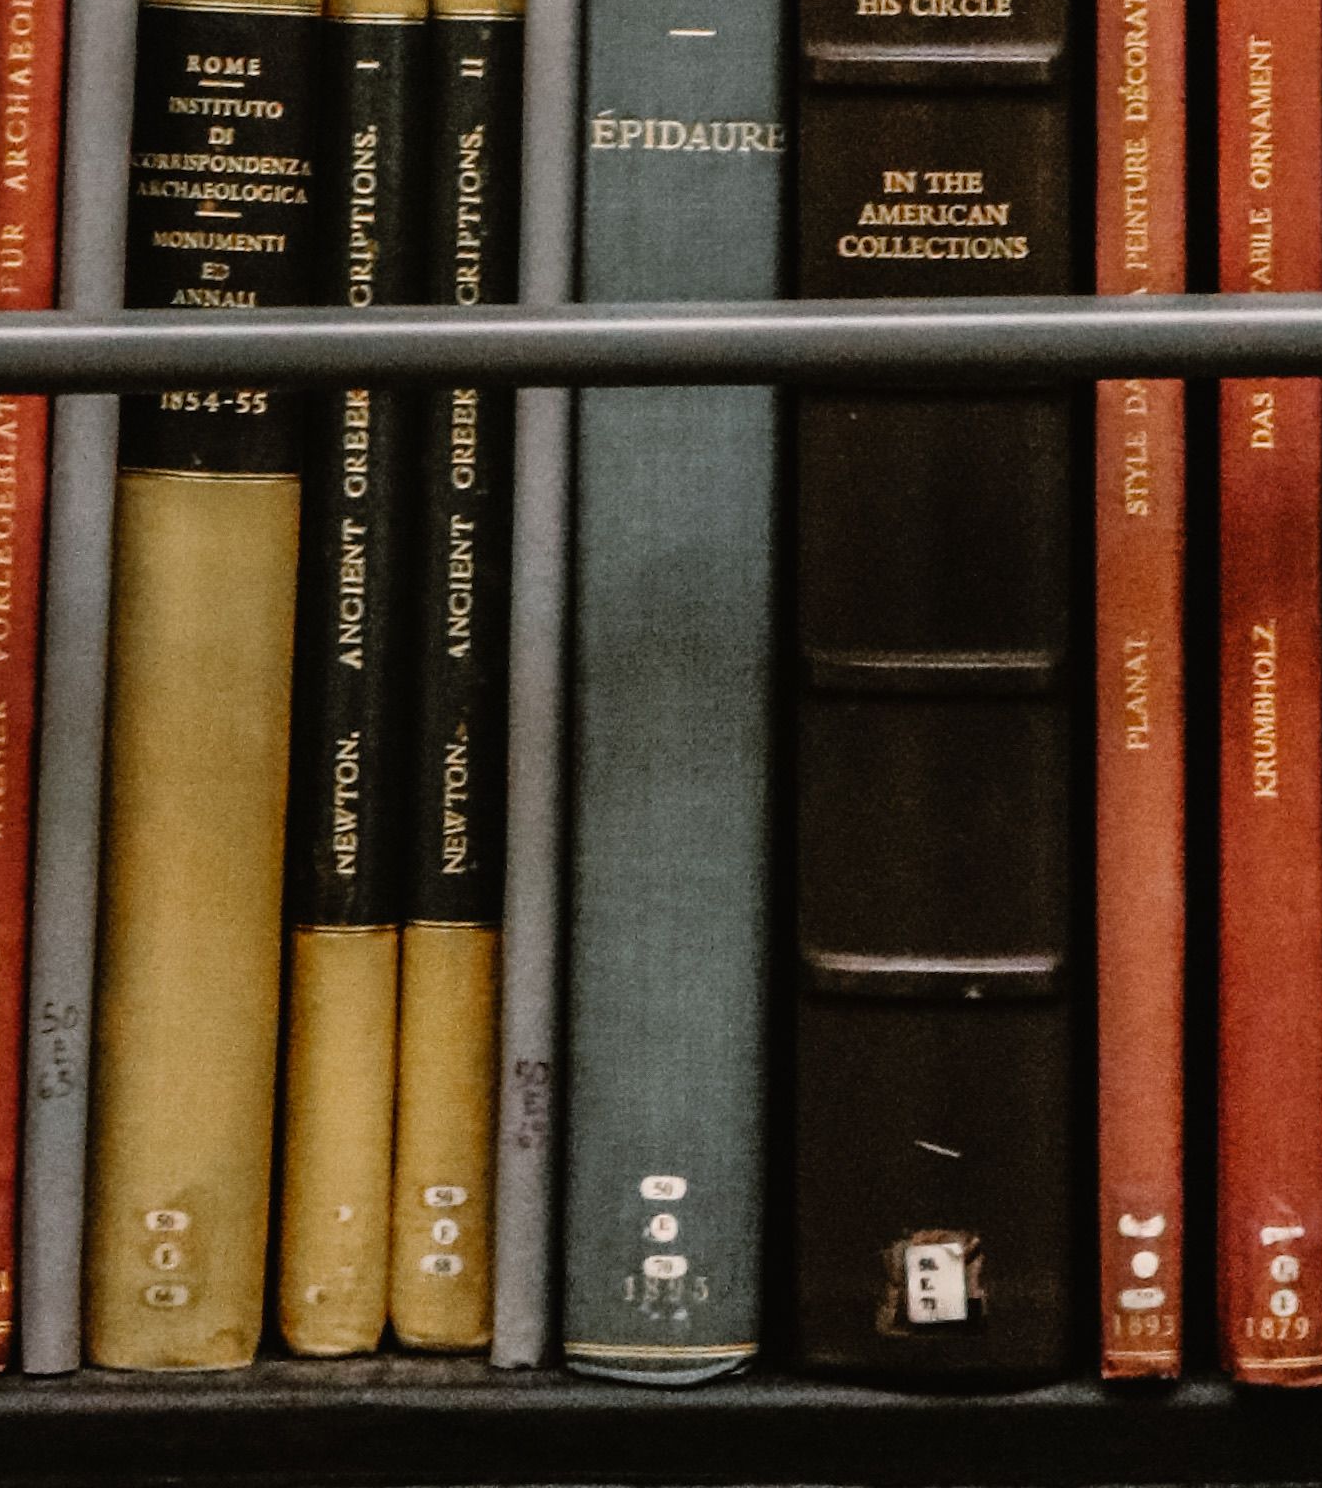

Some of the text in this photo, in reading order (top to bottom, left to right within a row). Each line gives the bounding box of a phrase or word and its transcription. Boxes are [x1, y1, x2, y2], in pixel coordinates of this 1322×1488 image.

[187, 55, 262, 76] ROME
[169, 97, 283, 118] INSTITUTO
[1250, 34, 1272, 190] ORNAMENT
[210, 125, 233, 147] DI
[591, 111, 786, 153] ÉPIDAURE
[883, 171, 983, 194] IN THE
[1127, 132, 1148, 270] PEINTURE
[858, 204, 1008, 227] AMERICAN
[153, 231, 285, 254] MONUMENTI
[838, 235, 1028, 260] COLLECTIONS
[201, 263, 229, 282] ED
[1251, 390, 1273, 450] DAS
[1126, 431, 1146, 517] STYLE
[338, 516, 367, 671] ANCIENT
[447, 514, 475, 658] ANCIENT
[336, 730, 361, 877] NEWTON.
[444, 725, 469, 875] NEWTON.
